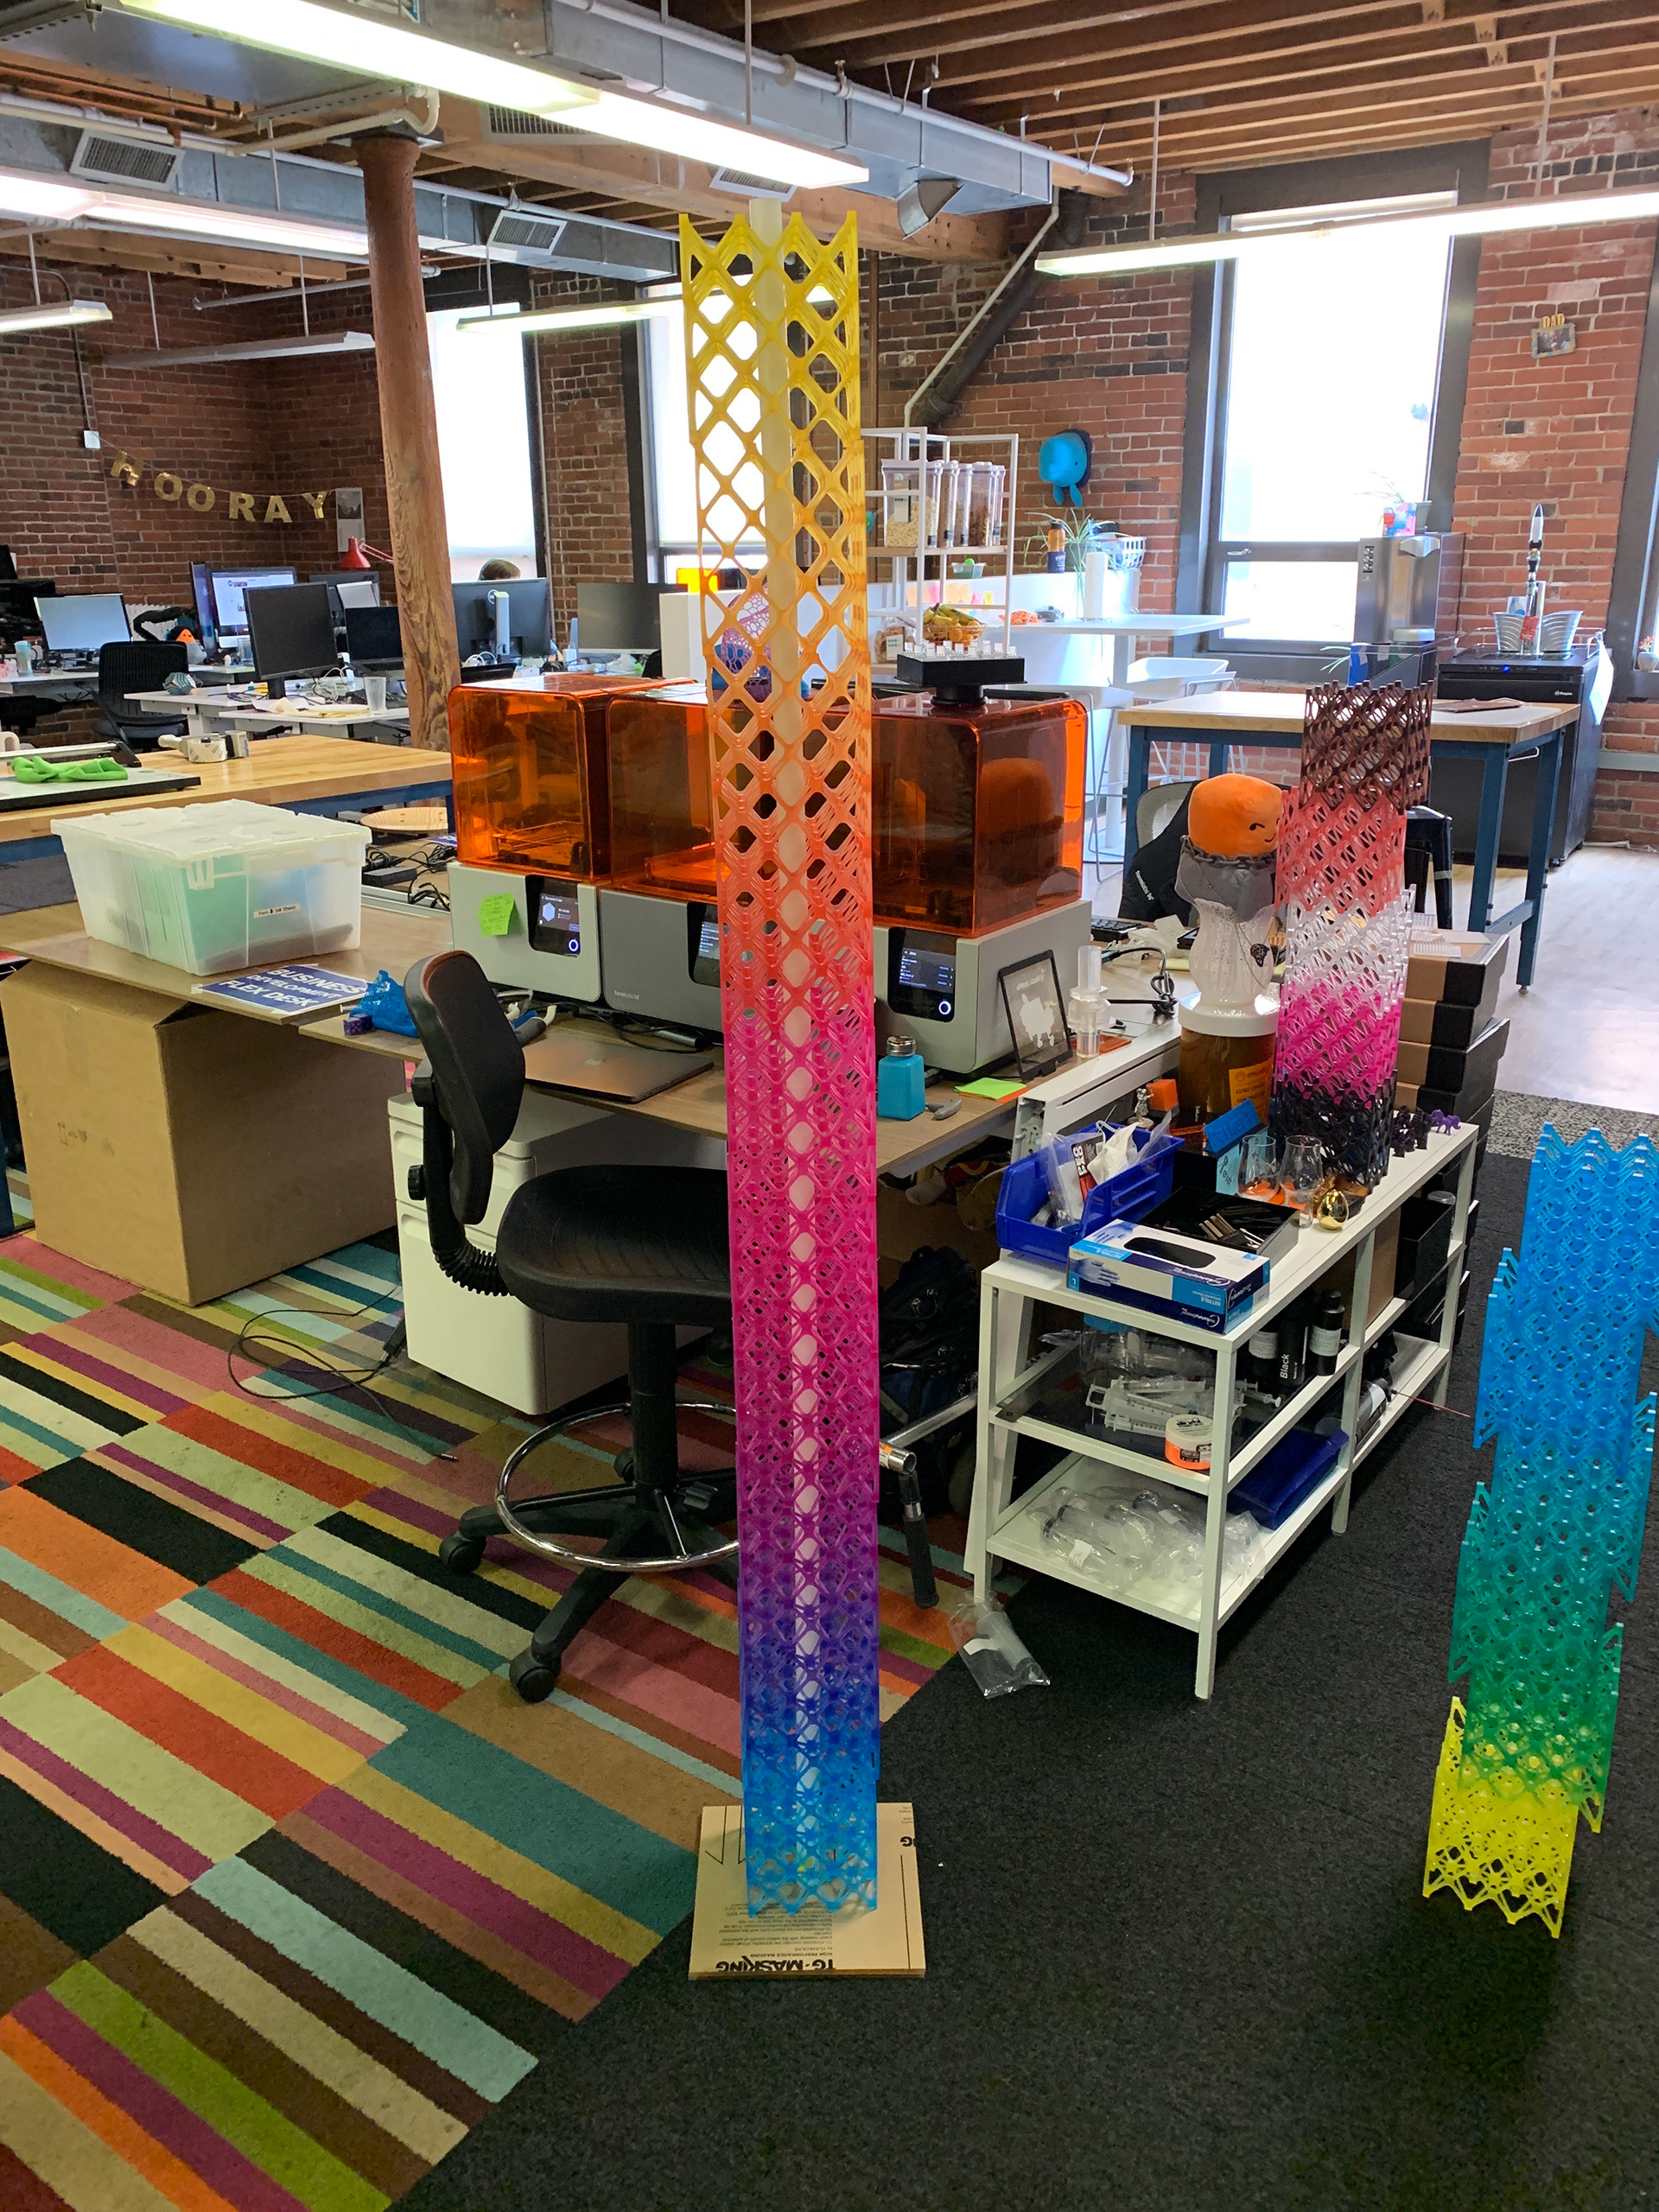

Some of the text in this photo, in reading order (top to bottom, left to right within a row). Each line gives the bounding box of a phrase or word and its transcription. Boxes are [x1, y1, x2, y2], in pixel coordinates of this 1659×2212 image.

[1542, 313, 1566, 328] DAD
[111, 449, 328, 524] HOORAY
[219, 980, 320, 1007] FLEX DESK
[247, 975, 343, 999] DEVELOPMENT
[267, 969, 363, 995] BUSINESS
[1280, 1353, 1290, 1379] Black
